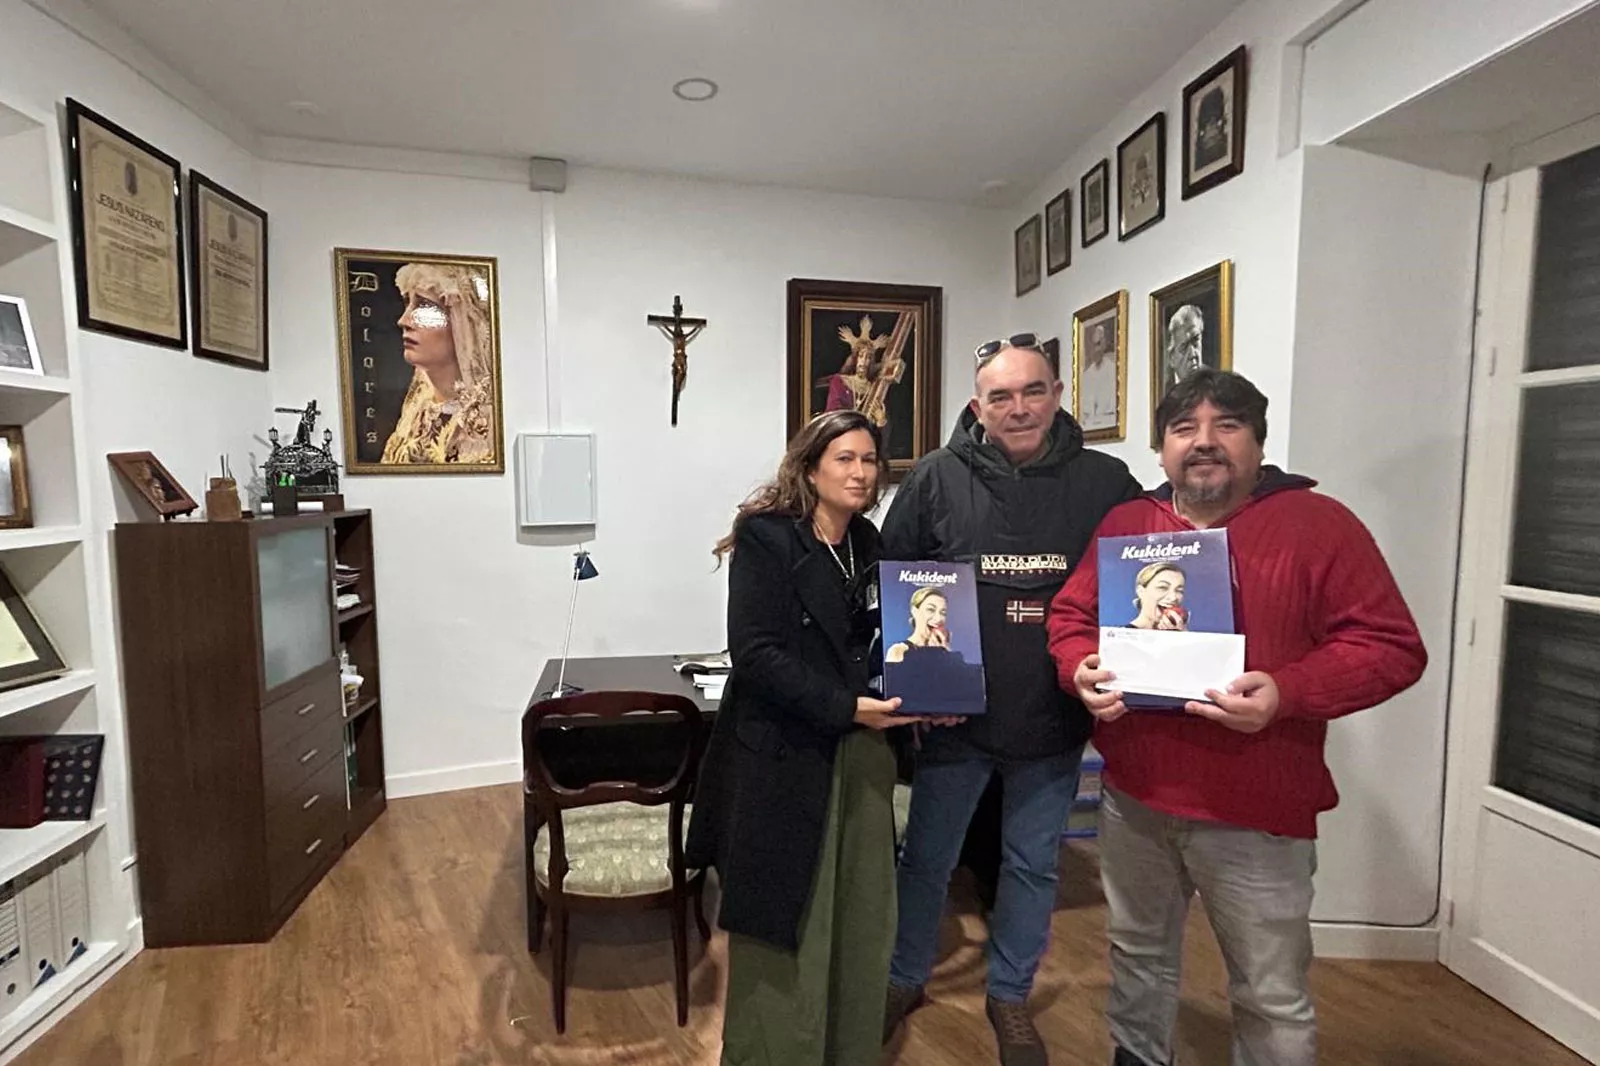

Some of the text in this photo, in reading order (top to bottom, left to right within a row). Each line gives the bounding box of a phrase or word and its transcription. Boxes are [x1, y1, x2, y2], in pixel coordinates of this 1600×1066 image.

[1121, 541, 1201, 559] Kukident
[981, 555, 1067, 570] NAPAPIJRI
[899, 570, 958, 583] Kukident
